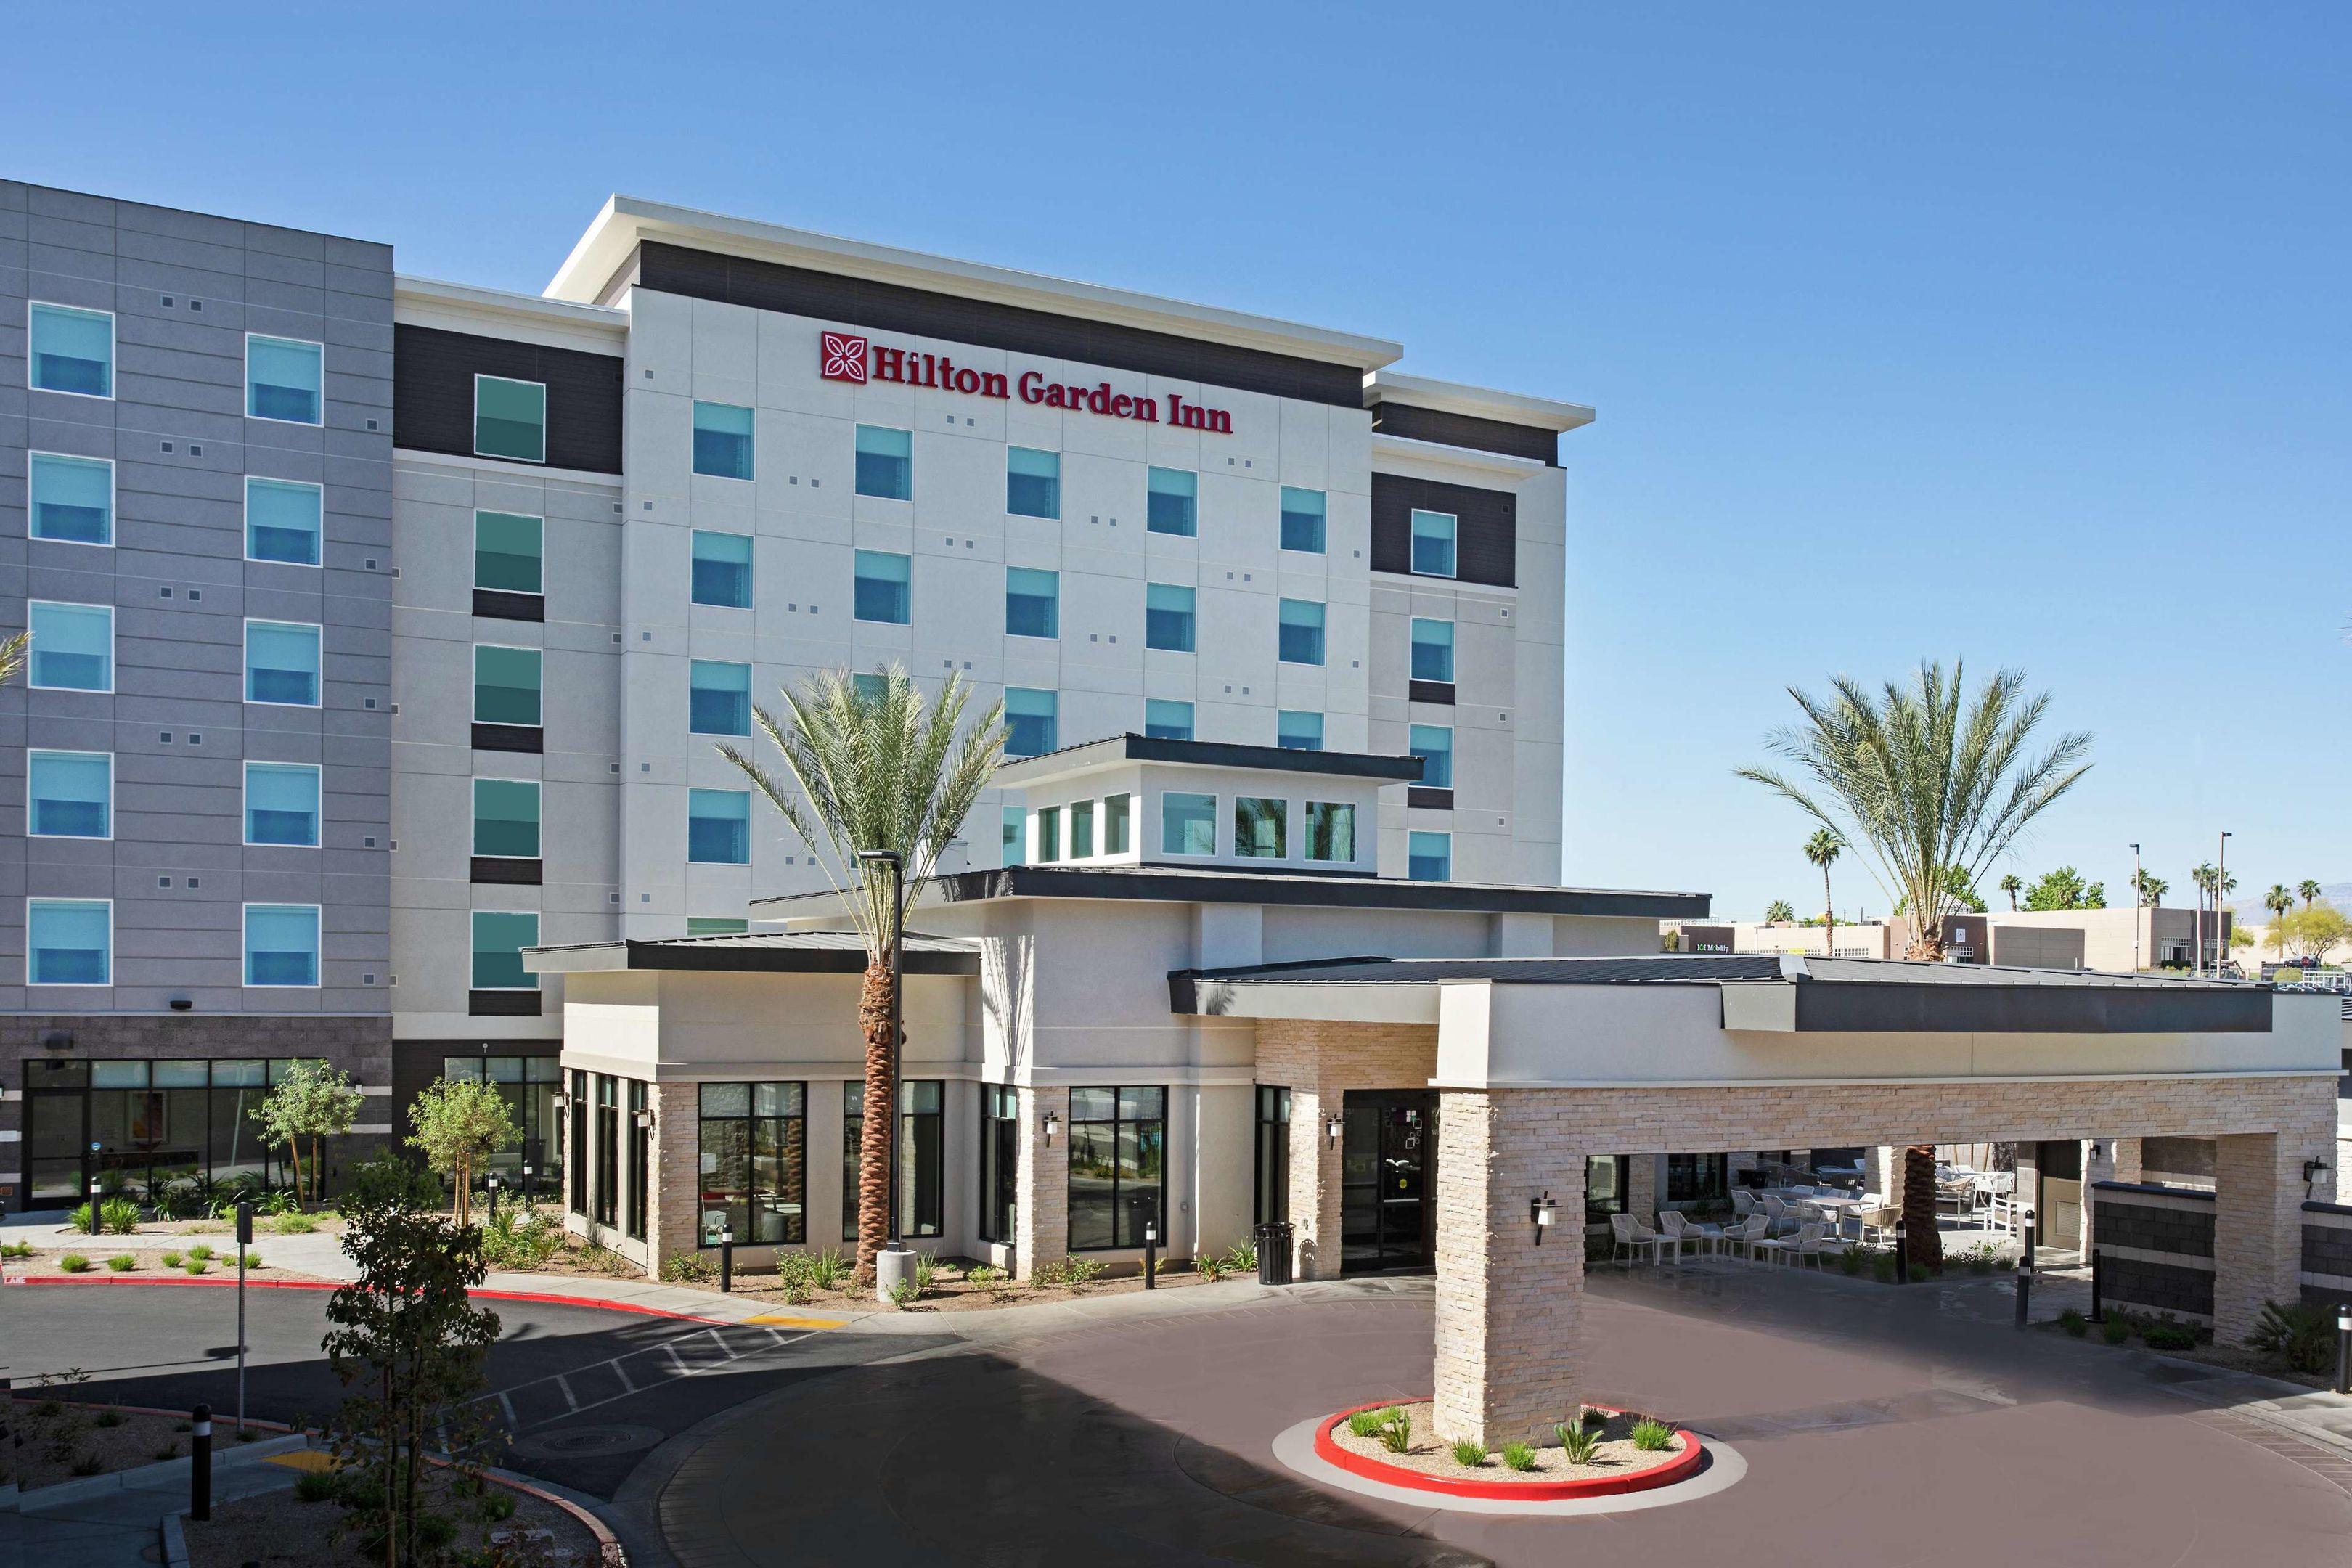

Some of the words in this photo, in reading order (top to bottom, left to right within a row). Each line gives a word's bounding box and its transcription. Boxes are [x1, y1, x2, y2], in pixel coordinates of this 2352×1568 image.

[873, 345, 1010, 399] Hilton
[1018, 370, 1159, 422] Garden
[1167, 393, 1233, 434] Inn
[1707, 944, 1728, 953] Mobility
